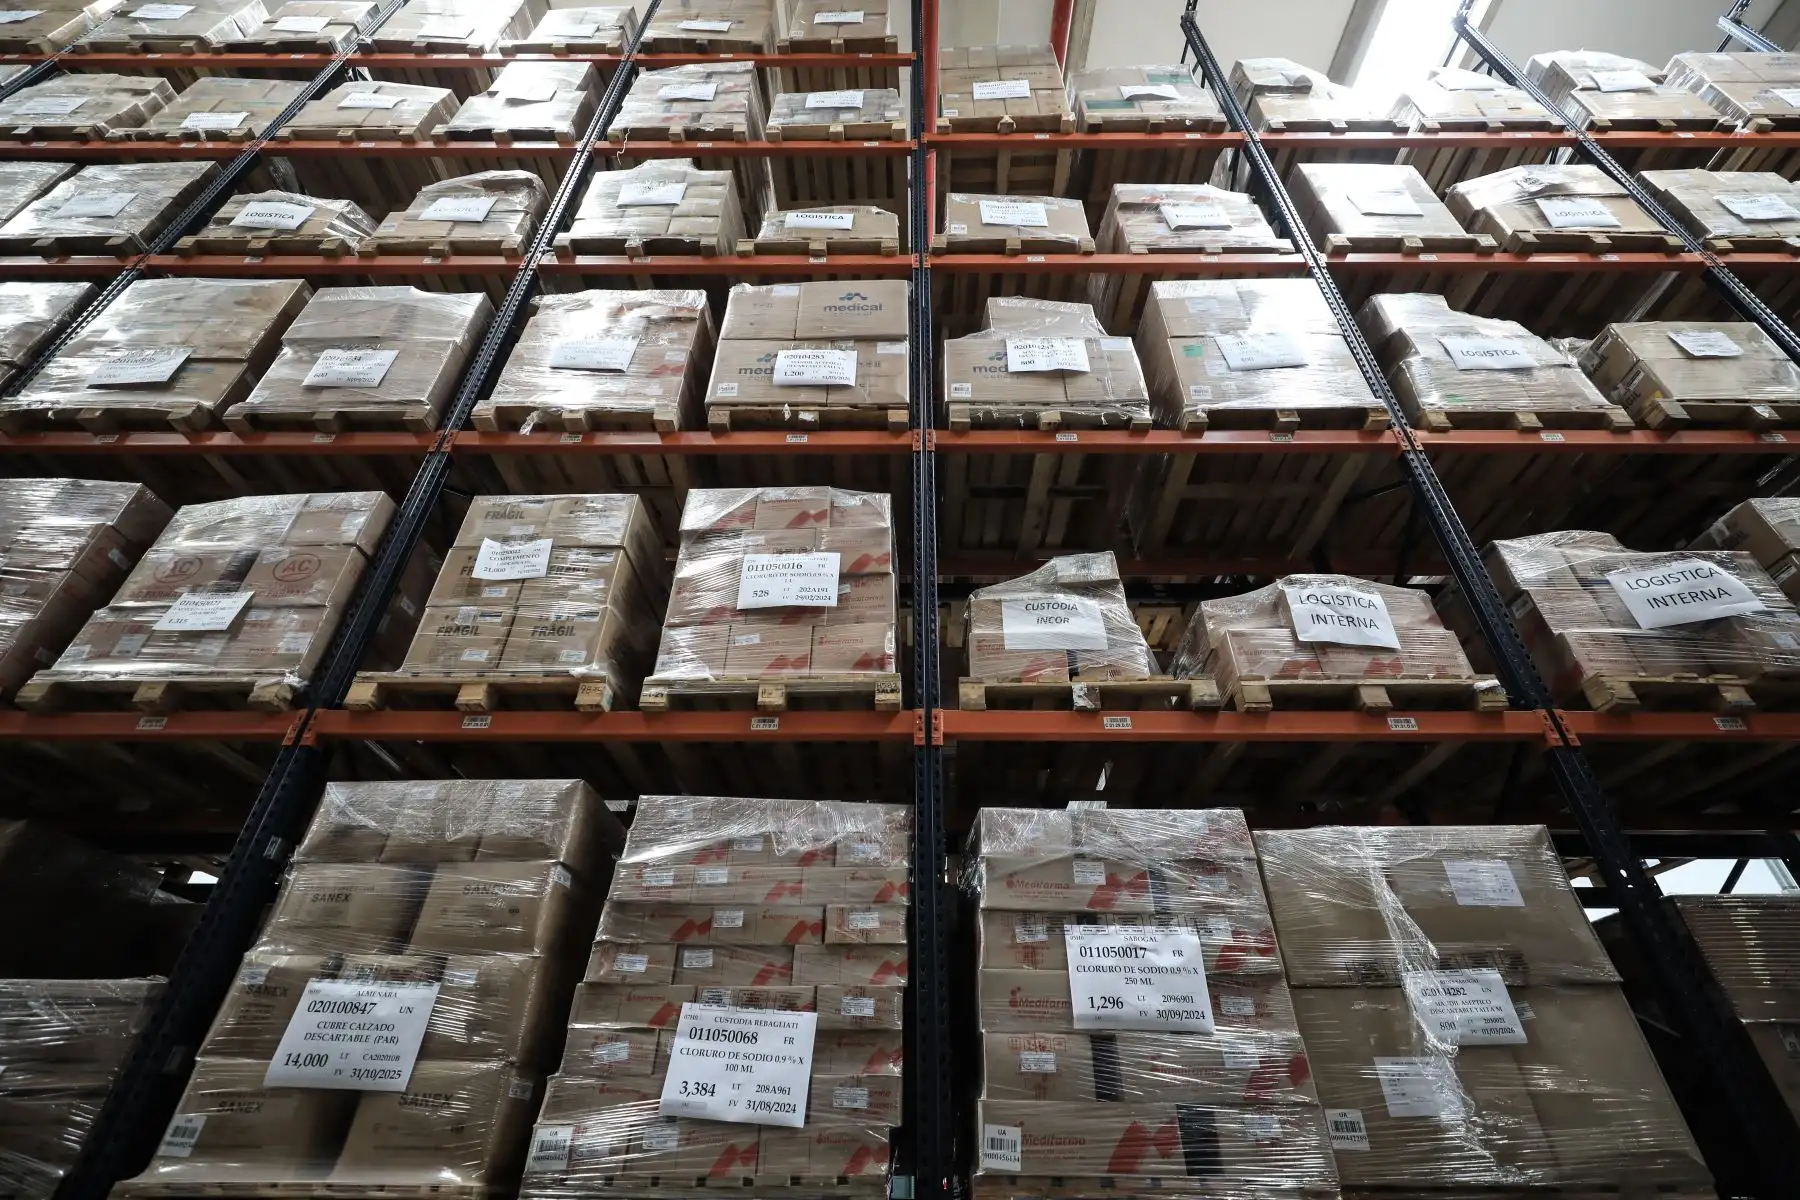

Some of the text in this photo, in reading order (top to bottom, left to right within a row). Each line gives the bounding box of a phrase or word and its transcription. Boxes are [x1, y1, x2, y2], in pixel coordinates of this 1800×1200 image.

[245, 212, 295, 220] LOGISTICA
[824, 304, 882, 312] medical
[1460, 349, 1521, 357] LOGISTICA
[282, 558, 312, 573] AC
[748, 562, 803, 572] 011050016
[1626, 567, 1722, 591] LOGISTICA
[752, 590, 770, 598] 528
[1646, 587, 1732, 609] INTERNA
[1025, 602, 1078, 611] CUSTODIA
[1298, 594, 1378, 610] LOGISTICA
[1036, 616, 1070, 624] INCOR
[1310, 614, 1380, 630] INTERNA
[312, 892, 352, 902] SANEX
[1080, 946, 1184, 959] 011050017 FR
[1076, 965, 1122, 974] CLORURO
[1124, 966, 1136, 974] DE
[1138, 966, 1168, 974] SODIO
[1170, 967, 1182, 975] 0.9
[1182, 966, 1192, 974] %
[1124, 977, 1155, 986] 250 ML
[356, 990, 398, 998] ALMENARA
[307, 1000, 414, 1014] 020100847 UN
[1088, 996, 1124, 1012] 1,296
[1162, 994, 1194, 1004] 2096901
[1156, 1010, 1206, 1022] 30/09/2024
[316, 1021, 394, 1032] CUBRE CALZADO
[714, 1016, 752, 1026] CUSTODIA
[754, 1019, 798, 1029] REBAGLIATI
[1440, 1021, 1456, 1031] 800
[304, 1033, 400, 1045] DESCARTABLE (PAR)
[689, 1026, 795, 1045] 011050068 FR
[284, 1053, 328, 1070] 14,000
[680, 1047, 806, 1064] CLORURO DE SODIO 0.9 % X
[350, 1068, 402, 1080] 31/10/2025
[724, 1064, 754, 1074] 100 ML
[679, 1080, 716, 1098] 3,384
[756, 1084, 792, 1096] 208A961
[745, 1100, 797, 1114] 31/08/2024
